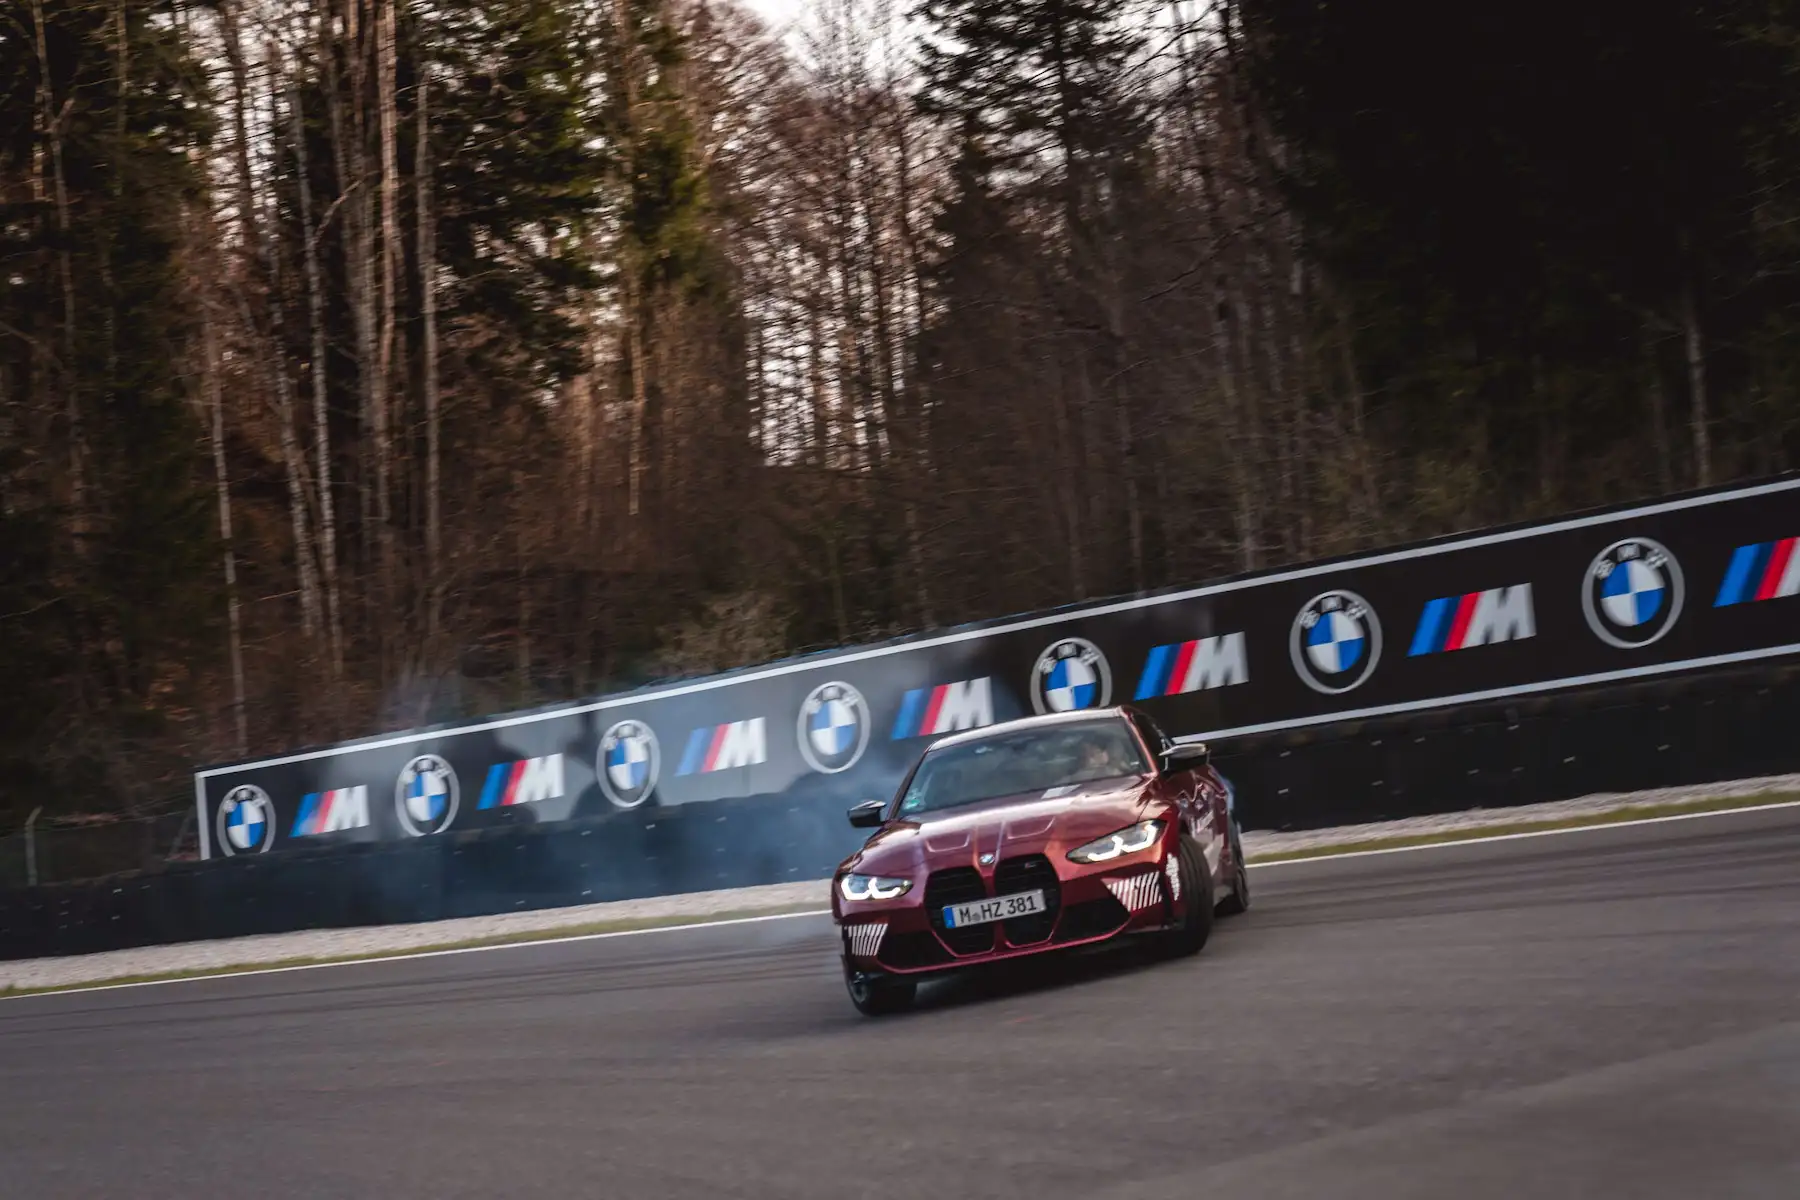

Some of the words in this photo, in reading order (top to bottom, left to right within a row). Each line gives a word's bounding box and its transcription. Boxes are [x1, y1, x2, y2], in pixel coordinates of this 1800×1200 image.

[1460, 582, 1536, 650] M
[1181, 632, 1250, 694] M
[930, 677, 994, 736] M
[710, 717, 767, 774] M
[512, 753, 566, 806] M
[320, 785, 370, 834] M
[959, 907, 972, 924] M
[980, 902, 1004, 919] HZ
[1007, 895, 1037, 915] 381
